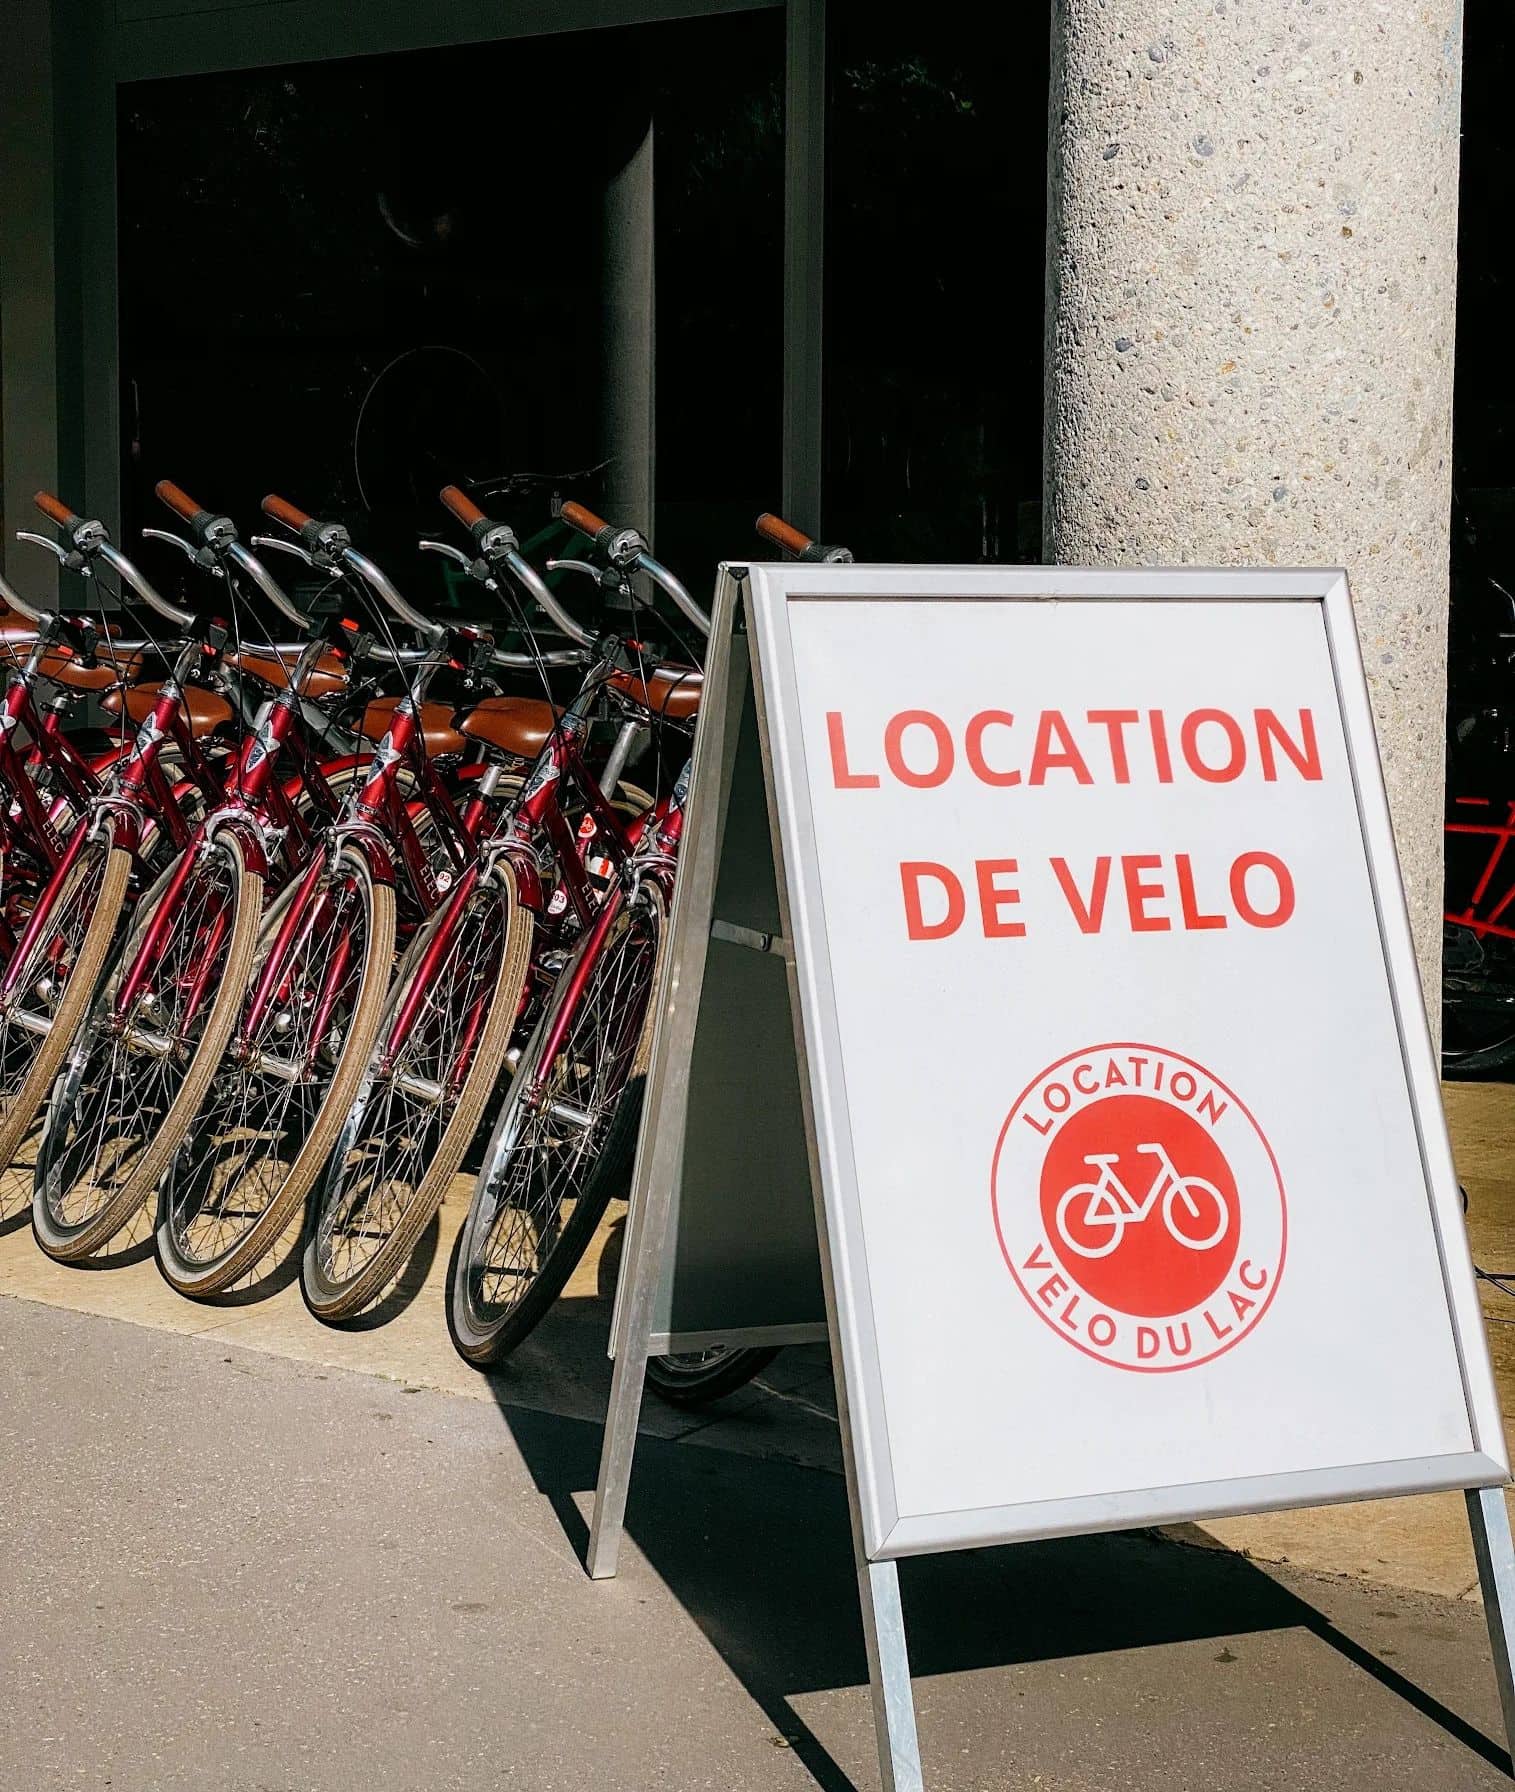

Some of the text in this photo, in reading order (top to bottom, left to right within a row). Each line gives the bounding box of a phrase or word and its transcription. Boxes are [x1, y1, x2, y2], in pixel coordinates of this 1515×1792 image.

[826, 708, 1323, 789] LOCATION
[900, 851, 1296, 941] DE VELO
[1023, 1056, 1228, 1136] LOCATION
[1023, 1243, 1268, 1359] VELO DU LAC
